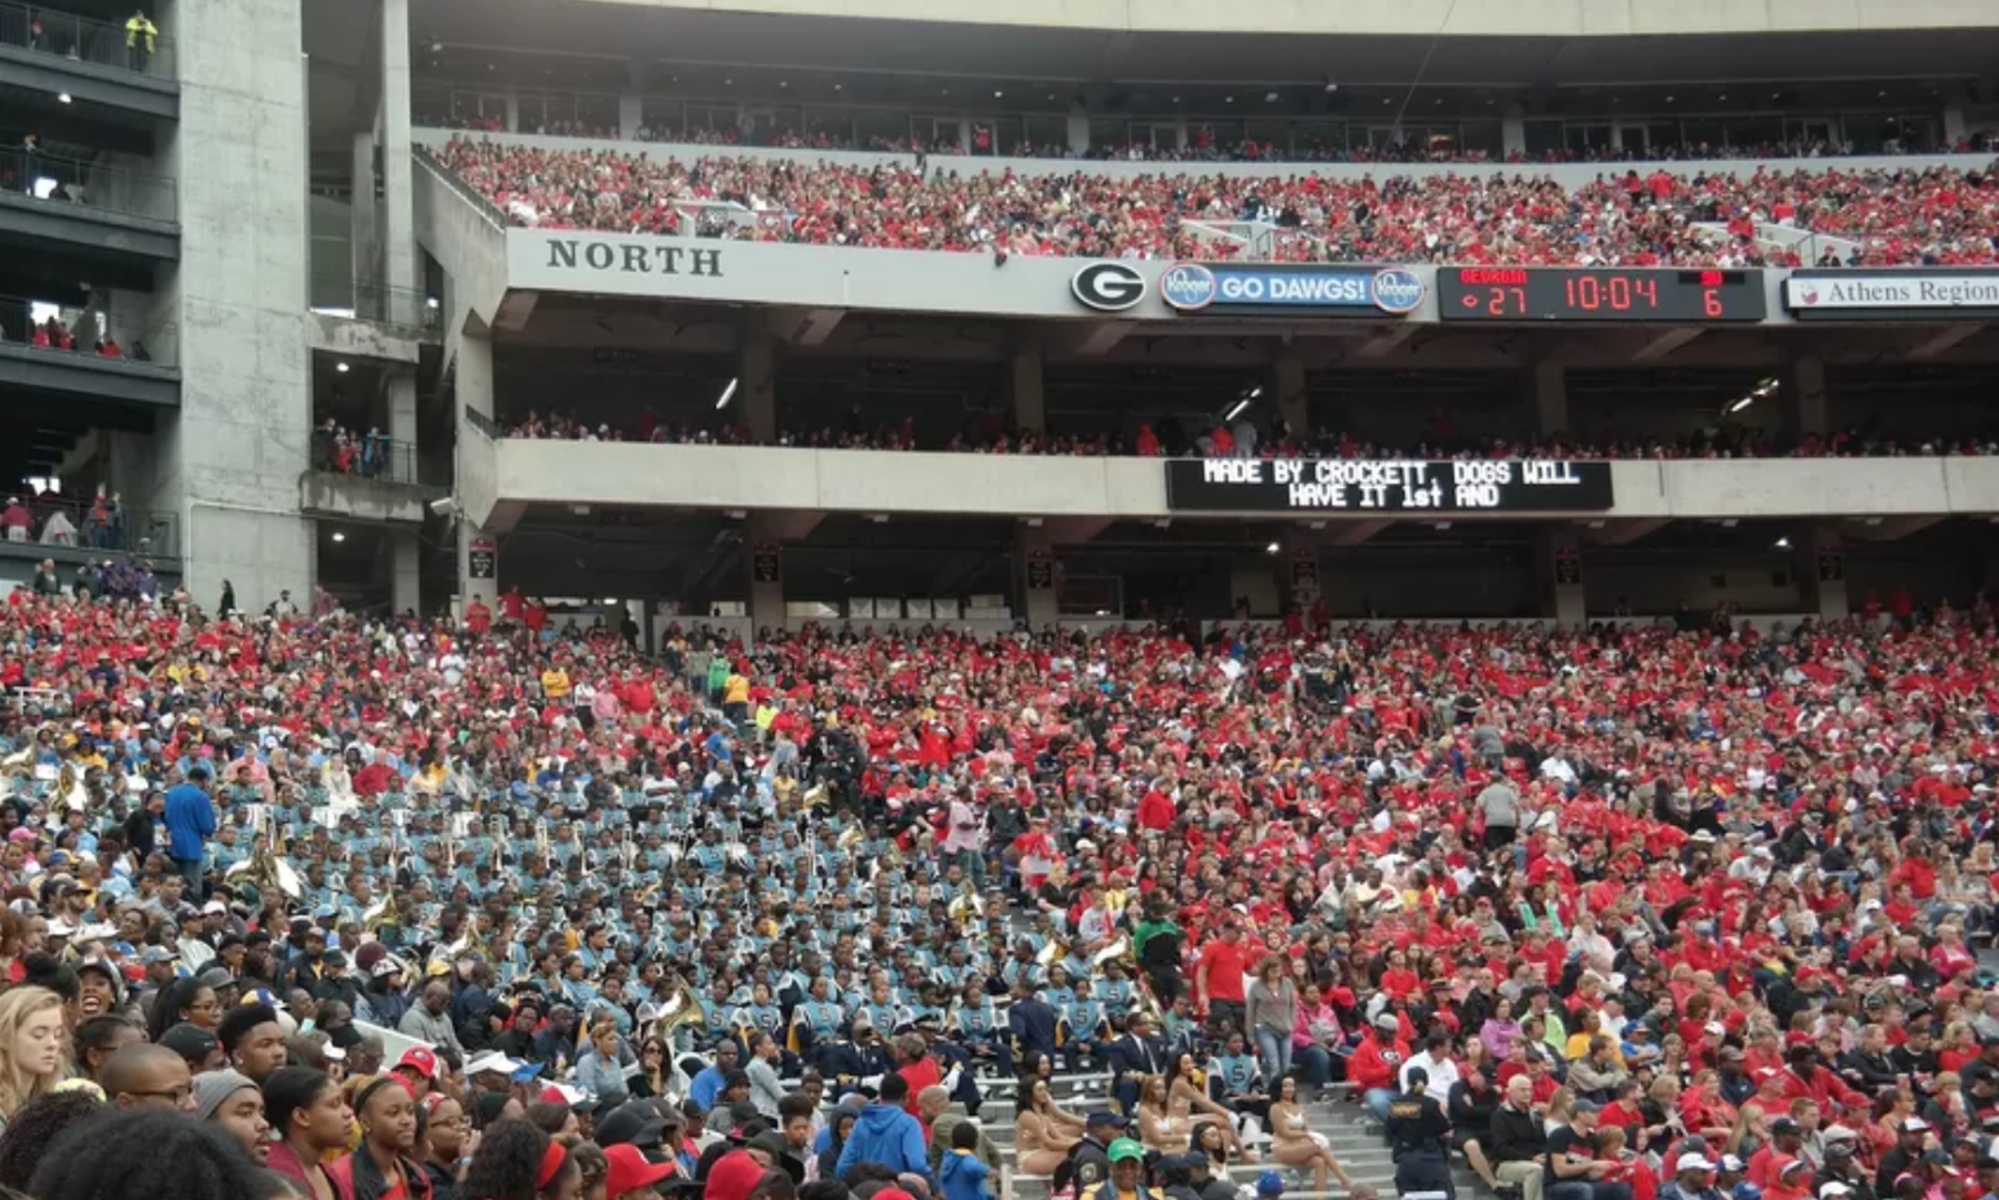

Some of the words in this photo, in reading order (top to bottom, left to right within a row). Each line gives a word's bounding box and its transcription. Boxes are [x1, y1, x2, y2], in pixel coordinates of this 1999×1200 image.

[546, 239, 724, 277] NORTH
[1075, 263, 1145, 308] G
[1166, 269, 1212, 301] Kroger
[1222, 278, 1262, 299] GO
[1270, 278, 1366, 300] DAWGS!
[1377, 273, 1420, 304] Kroger
[1566, 275, 1656, 310] 10:04
[1829, 281, 1910, 301] Athens
[1919, 280, 1998, 306] Region
[1489, 287, 1525, 315] 27
[1704, 289, 1723, 316] 6
[1203, 460, 1262, 482] MADE
[1275, 460, 1303, 482] BY
[1454, 461, 1511, 483] DOGS
[1523, 461, 1580, 483] WILL
[1289, 485, 1345, 507] HAVE
[1360, 485, 1388, 507] IT
[1402, 485, 1442, 507] 1st
[1456, 485, 1499, 507] AND
[711, 1010, 723, 1026] S
[760, 1013, 773, 1028] S
[1075, 1008, 1088, 1026] S
[1230, 1063, 1246, 1084] S
